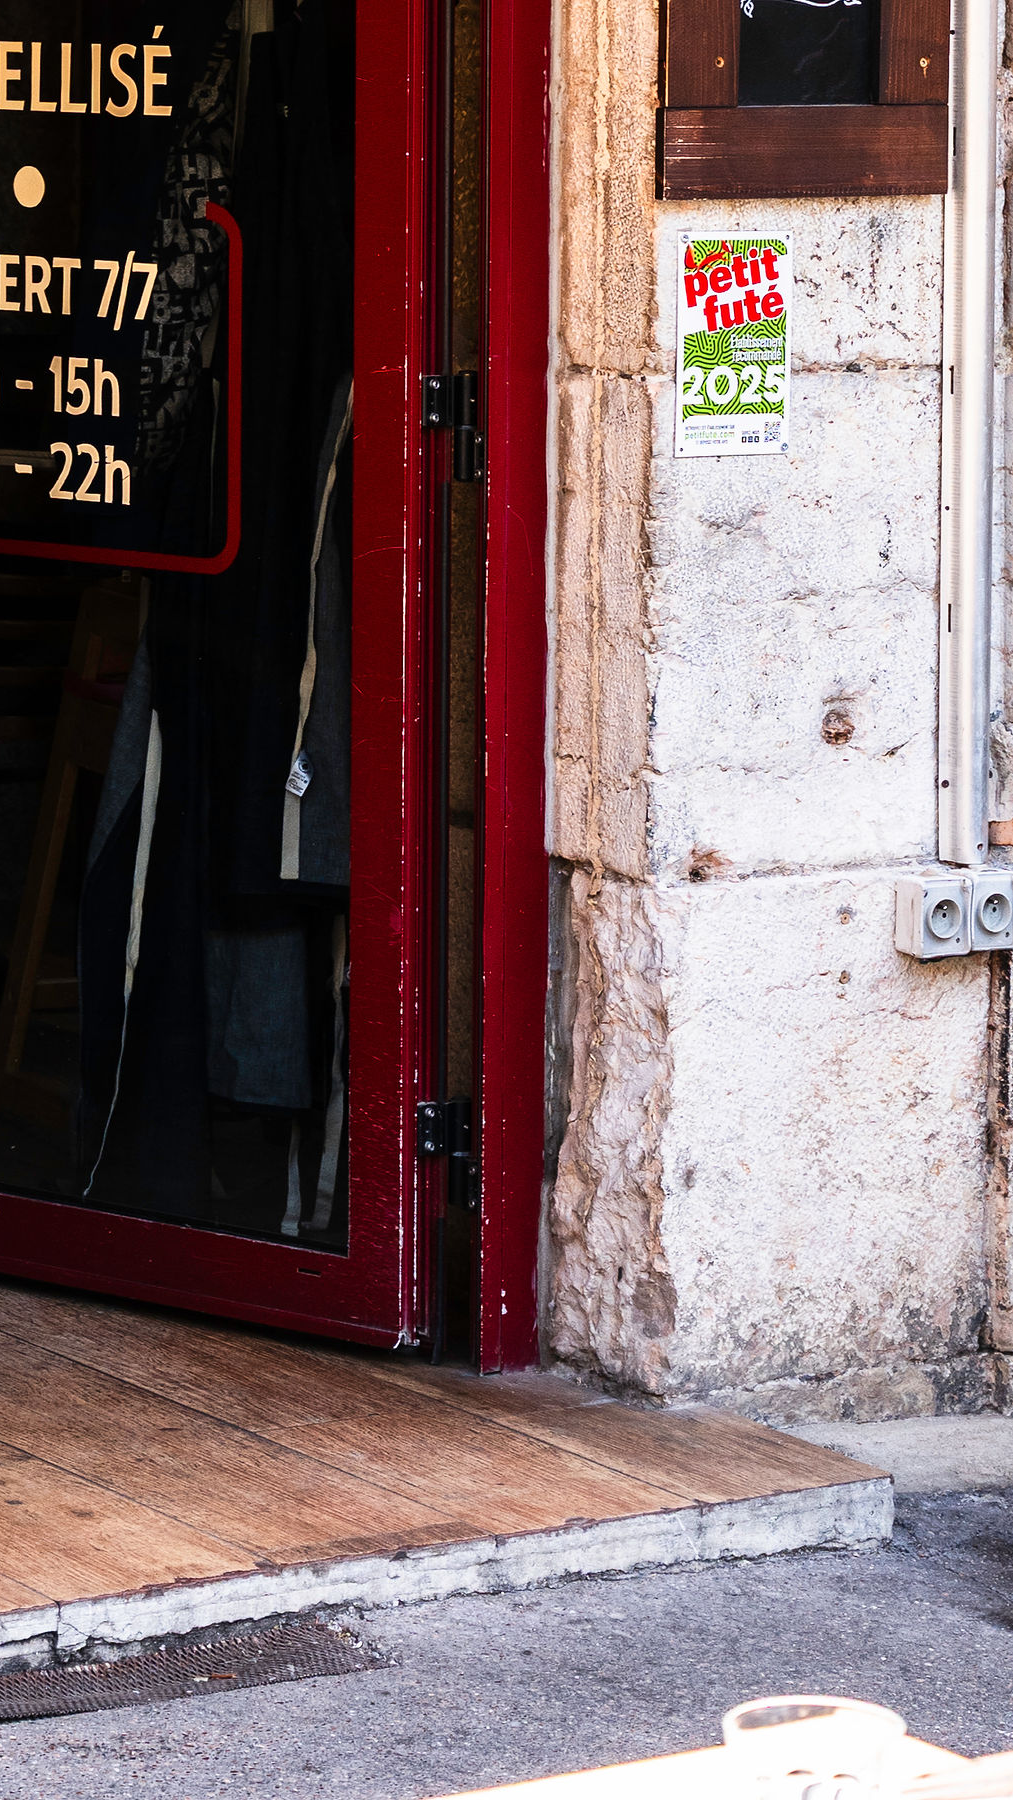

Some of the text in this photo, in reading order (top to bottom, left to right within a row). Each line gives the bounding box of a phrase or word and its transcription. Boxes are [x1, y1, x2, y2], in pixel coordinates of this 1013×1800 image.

[93, 250, 159, 331] 7/7
[684, 247, 780, 308] petit
[703, 284, 785, 333] futé
[49, 355, 121, 417] 15h
[683, 365, 786, 406] 2025
[49, 441, 131, 506] 22h
